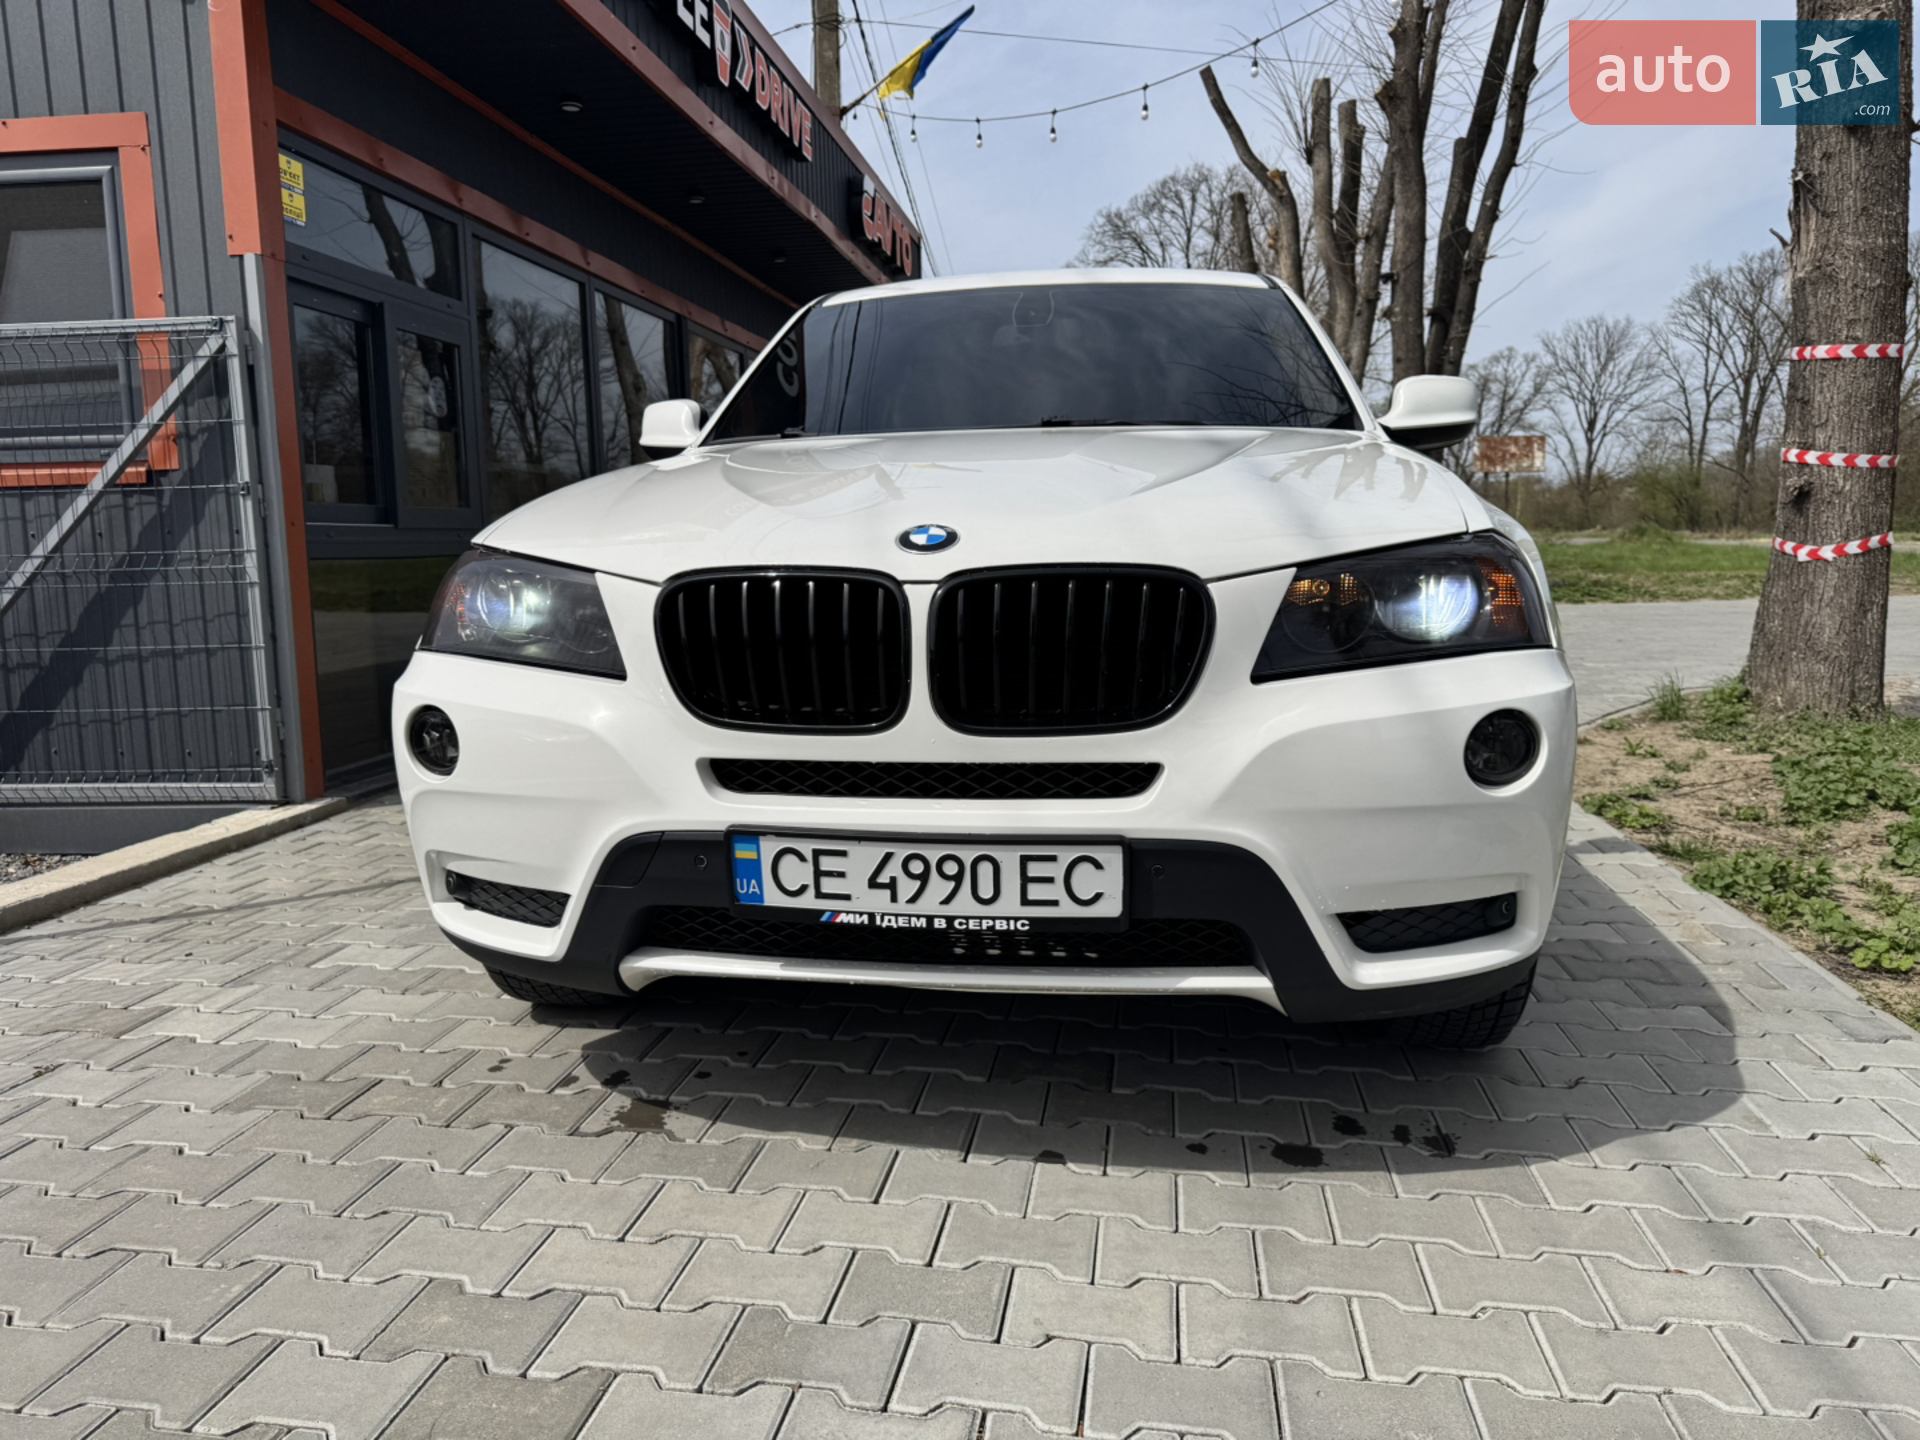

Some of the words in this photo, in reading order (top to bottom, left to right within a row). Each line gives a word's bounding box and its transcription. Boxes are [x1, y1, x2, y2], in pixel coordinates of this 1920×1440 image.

[755, 46, 813, 162] DRIVE
[736, 878, 761, 895] UA
[771, 846, 852, 901] CE
[867, 851, 1001, 907] 4990
[1019, 854, 1105, 908] EC
[835, 912, 869, 925] МИ
[875, 913, 927, 929] ЇДЕМ
[934, 917, 947, 930] В
[953, 918, 1031, 931] СЕРВІС
